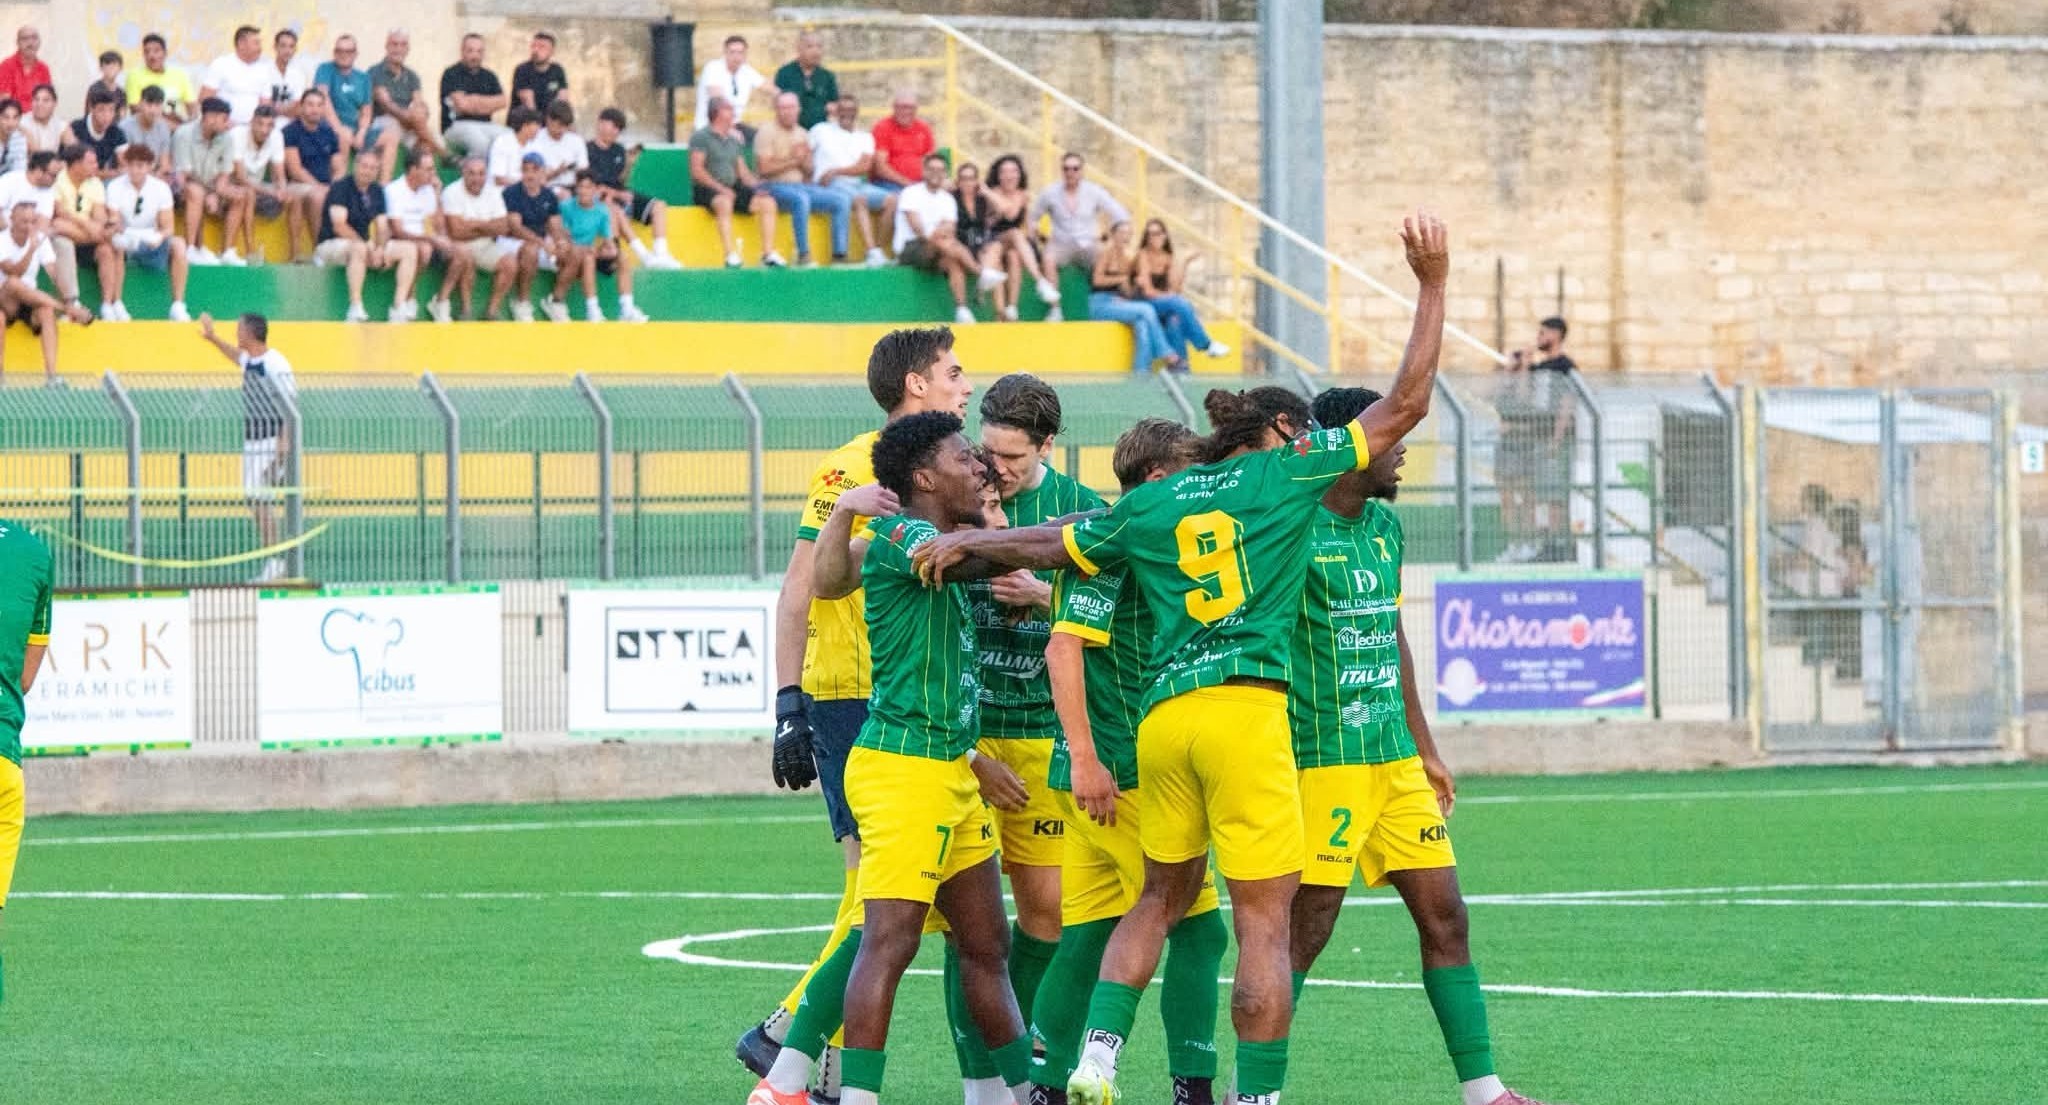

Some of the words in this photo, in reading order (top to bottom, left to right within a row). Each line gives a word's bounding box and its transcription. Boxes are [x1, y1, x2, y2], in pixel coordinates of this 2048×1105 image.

[1175, 510, 1252, 627] 9
[1069, 594, 1113, 612] EMULO
[1073, 603, 1105, 617] MOTORS
[617, 629, 756, 658] OTTICA
[362, 667, 416, 692] cibus
[1329, 807, 1352, 848] 2
[936, 825, 951, 865] 7
